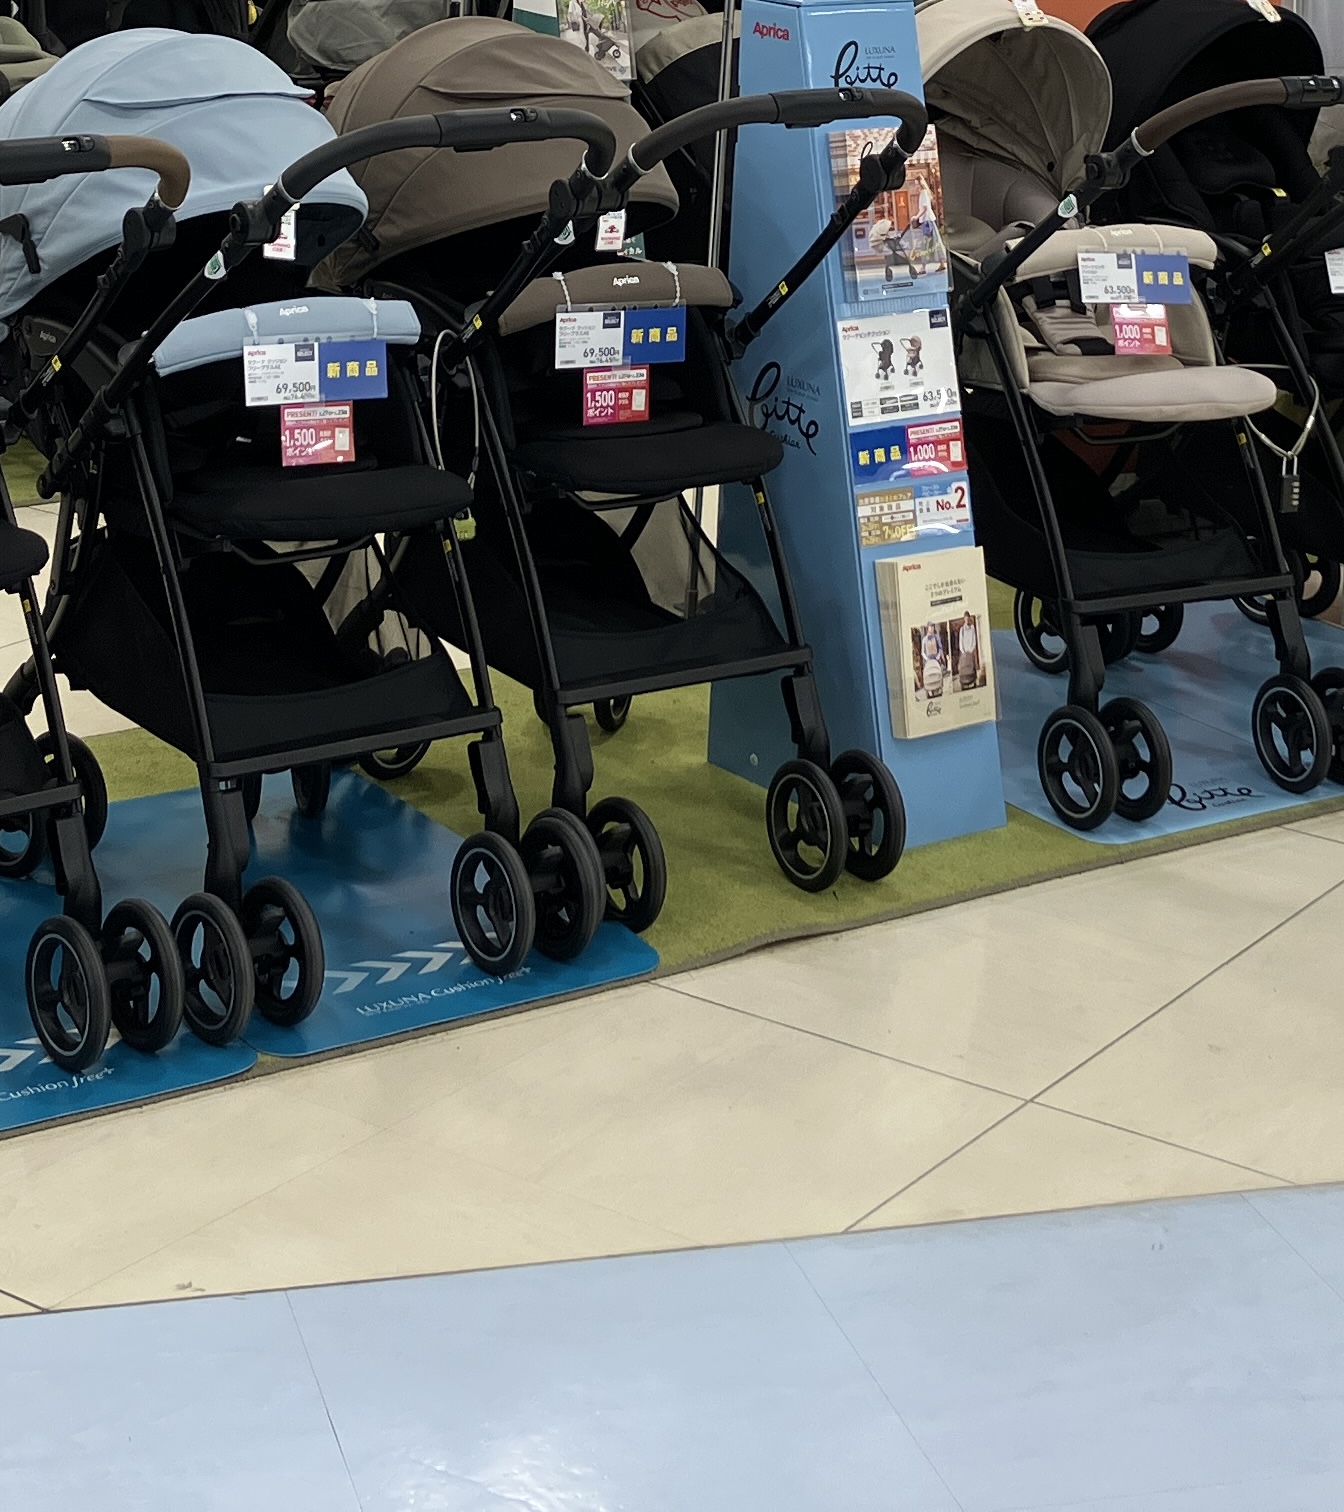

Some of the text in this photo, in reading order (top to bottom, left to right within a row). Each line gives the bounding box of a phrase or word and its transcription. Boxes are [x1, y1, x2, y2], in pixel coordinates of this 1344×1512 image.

[752, 21, 791, 41] Aprica
[1115, 324, 1141, 340] 1,000
[586, 389, 616, 408] 1,500
[586, 406, 615, 418] ポイント
[284, 428, 316, 447] 1,500
[909, 443, 936, 461] 1,000
[935, 486, 967, 512] No.2
